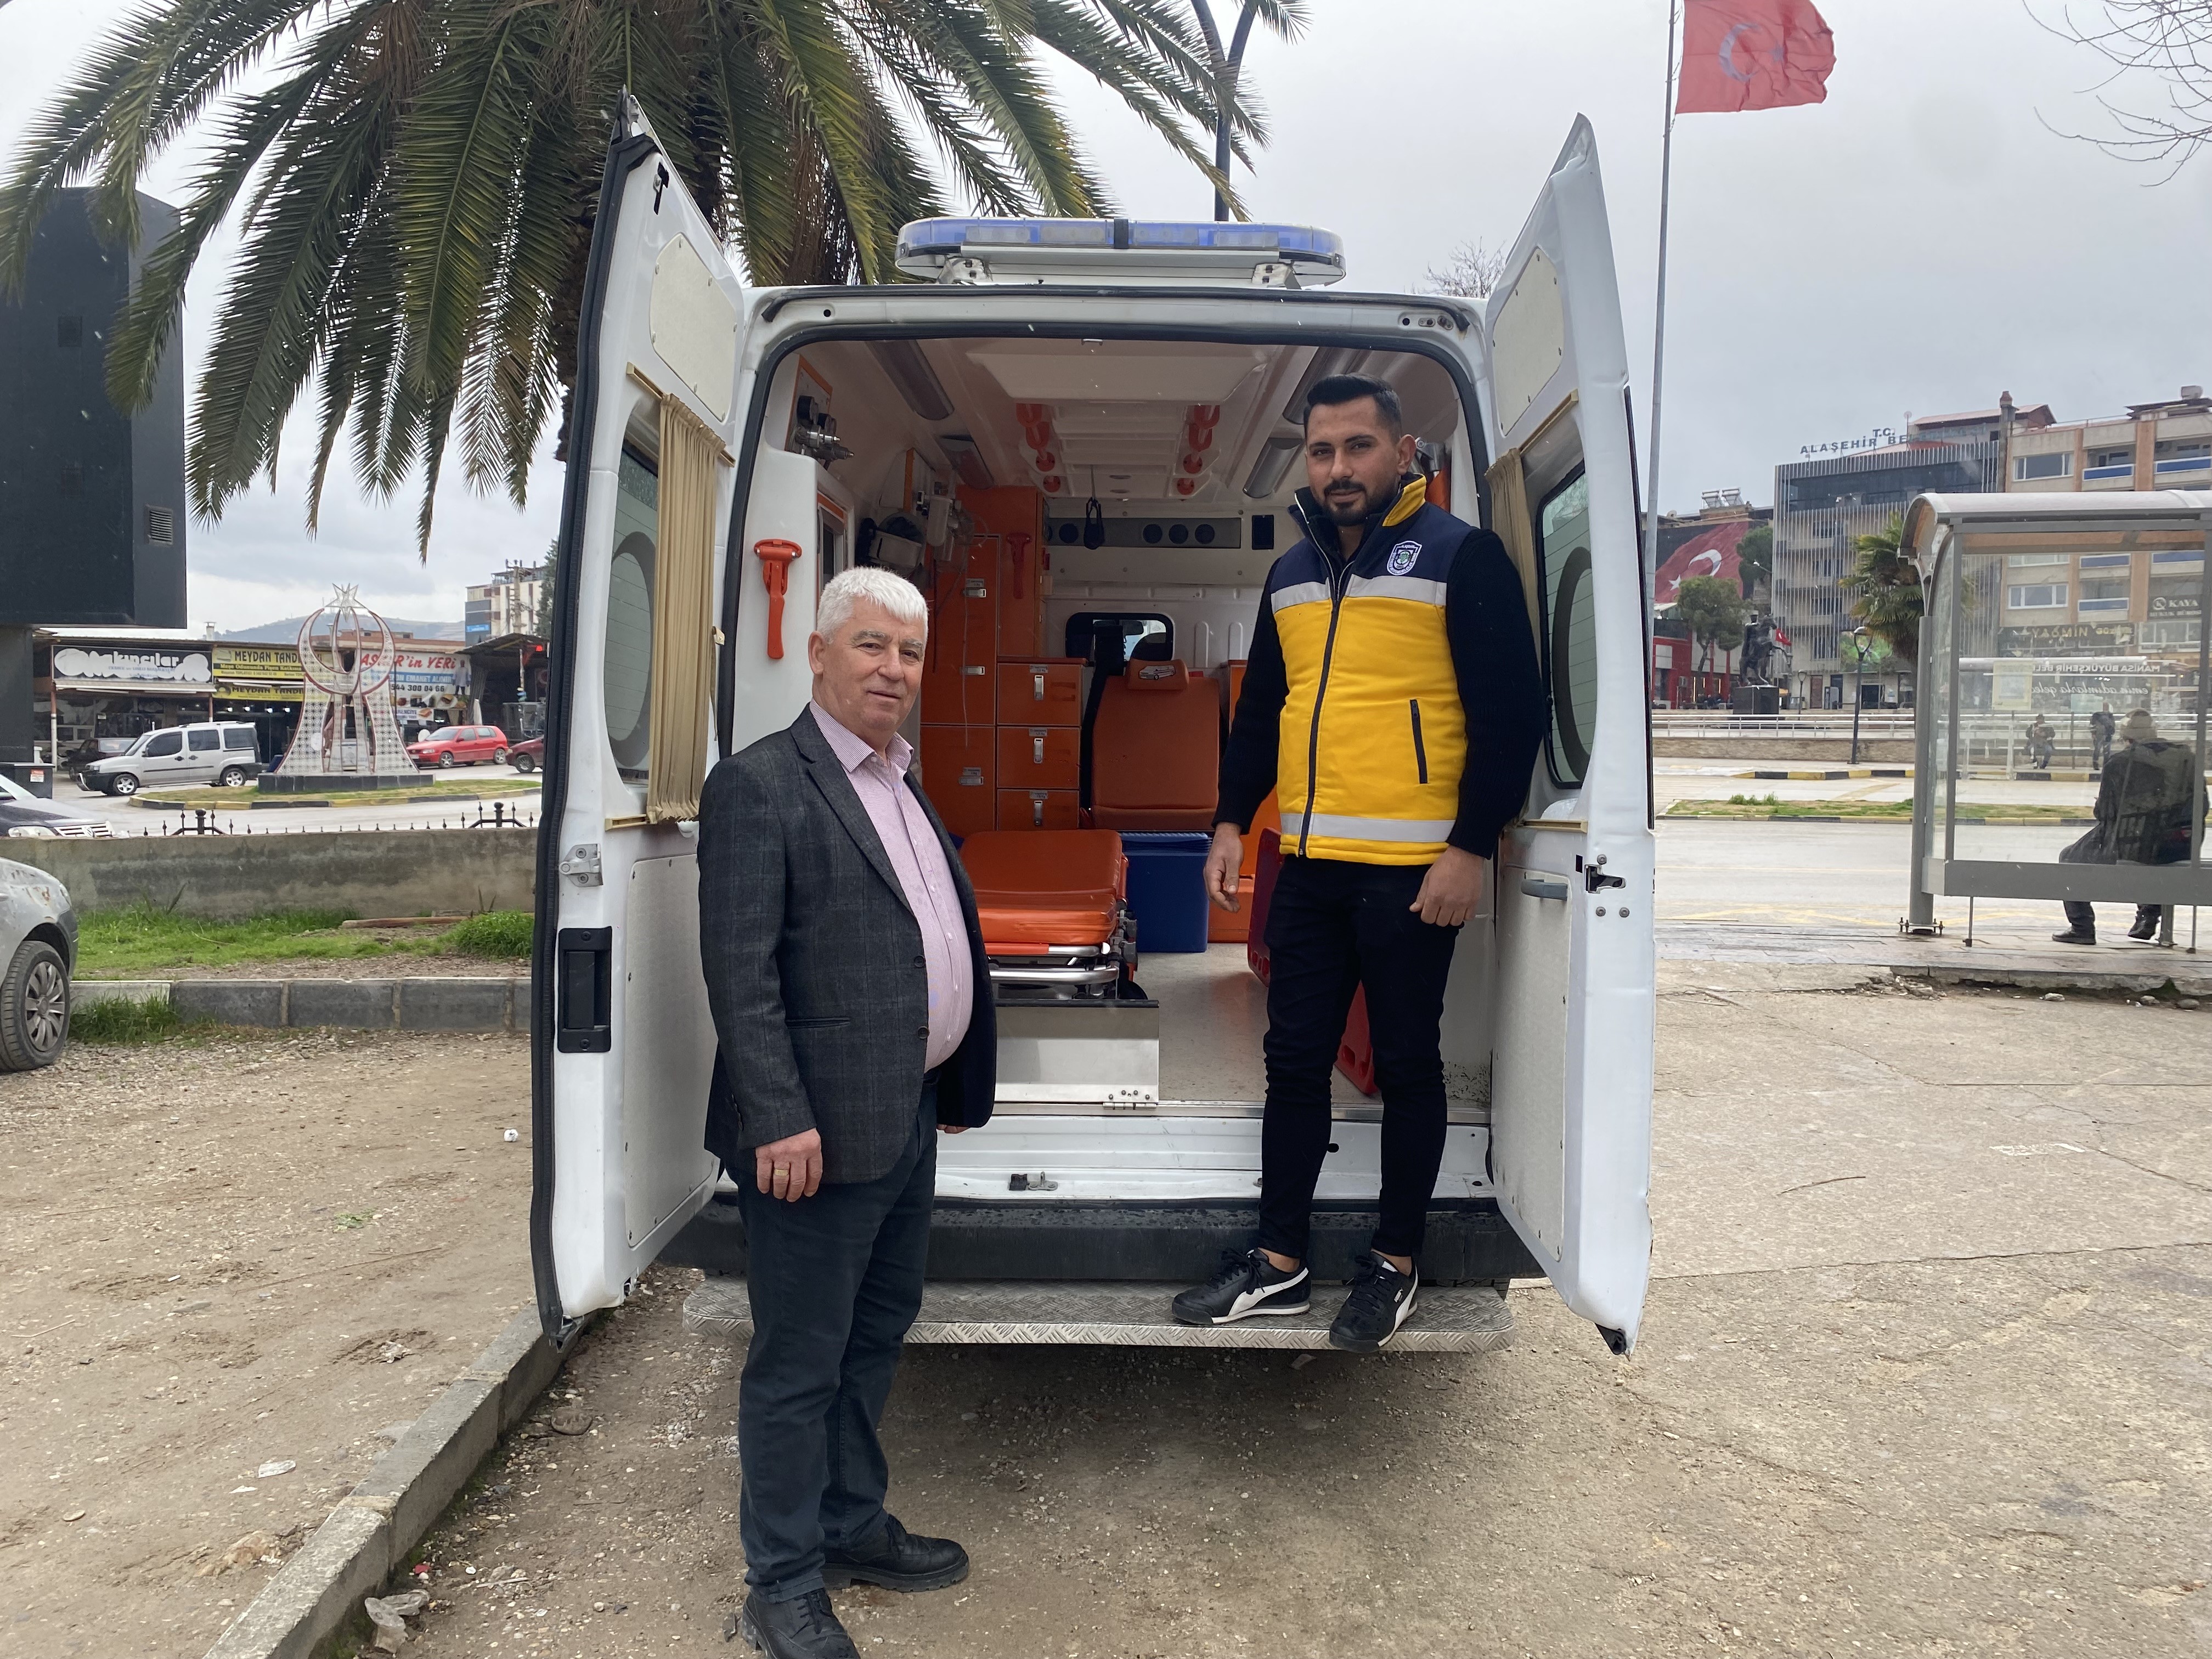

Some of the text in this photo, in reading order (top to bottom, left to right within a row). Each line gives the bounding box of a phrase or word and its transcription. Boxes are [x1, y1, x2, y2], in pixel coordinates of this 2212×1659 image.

[1872, 428, 1895, 438] T.C.
[1800, 436, 1877, 455] ALAŞEHİR
[2169, 599, 2198, 607] KAYA
[235, 650, 271, 663] MEYDAN
